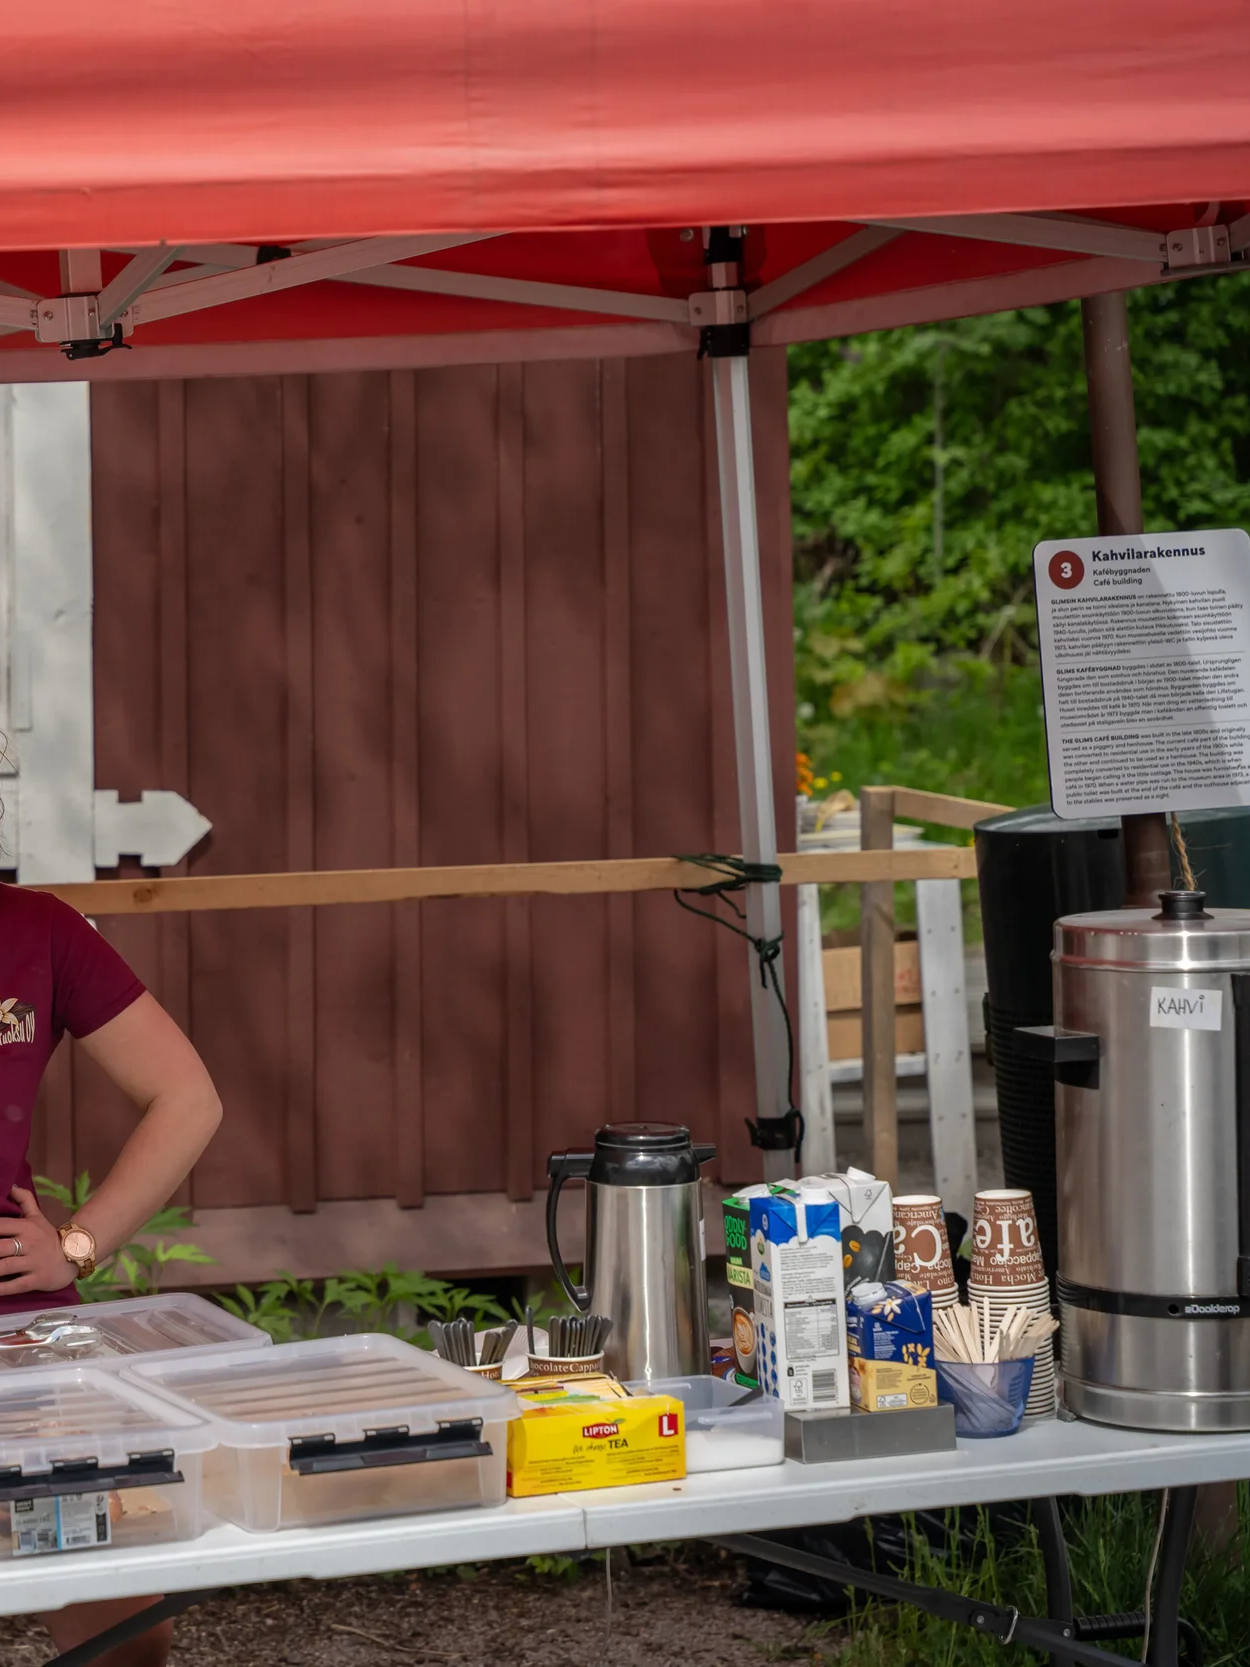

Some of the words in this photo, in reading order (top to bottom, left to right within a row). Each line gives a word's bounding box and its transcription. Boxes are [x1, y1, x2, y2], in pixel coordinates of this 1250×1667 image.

[1092, 546, 1206, 562] Kahvilarakennus
[1060, 562, 1072, 578] 3
[1093, 567, 1150, 576] Kafébyggnaden
[1112, 577, 1143, 585] building
[1077, 594, 1136, 603] KAHVILARAKENNUS
[1076, 664, 1121, 673] KAFÉBYGGNAD
[1001, 1273, 1036, 1285] Mocha
[1191, 1304, 1240, 1315] Daalderop
[584, 1424, 618, 1437] LIPTON
[662, 1416, 675, 1435] L
[607, 1439, 629, 1449] TEA
